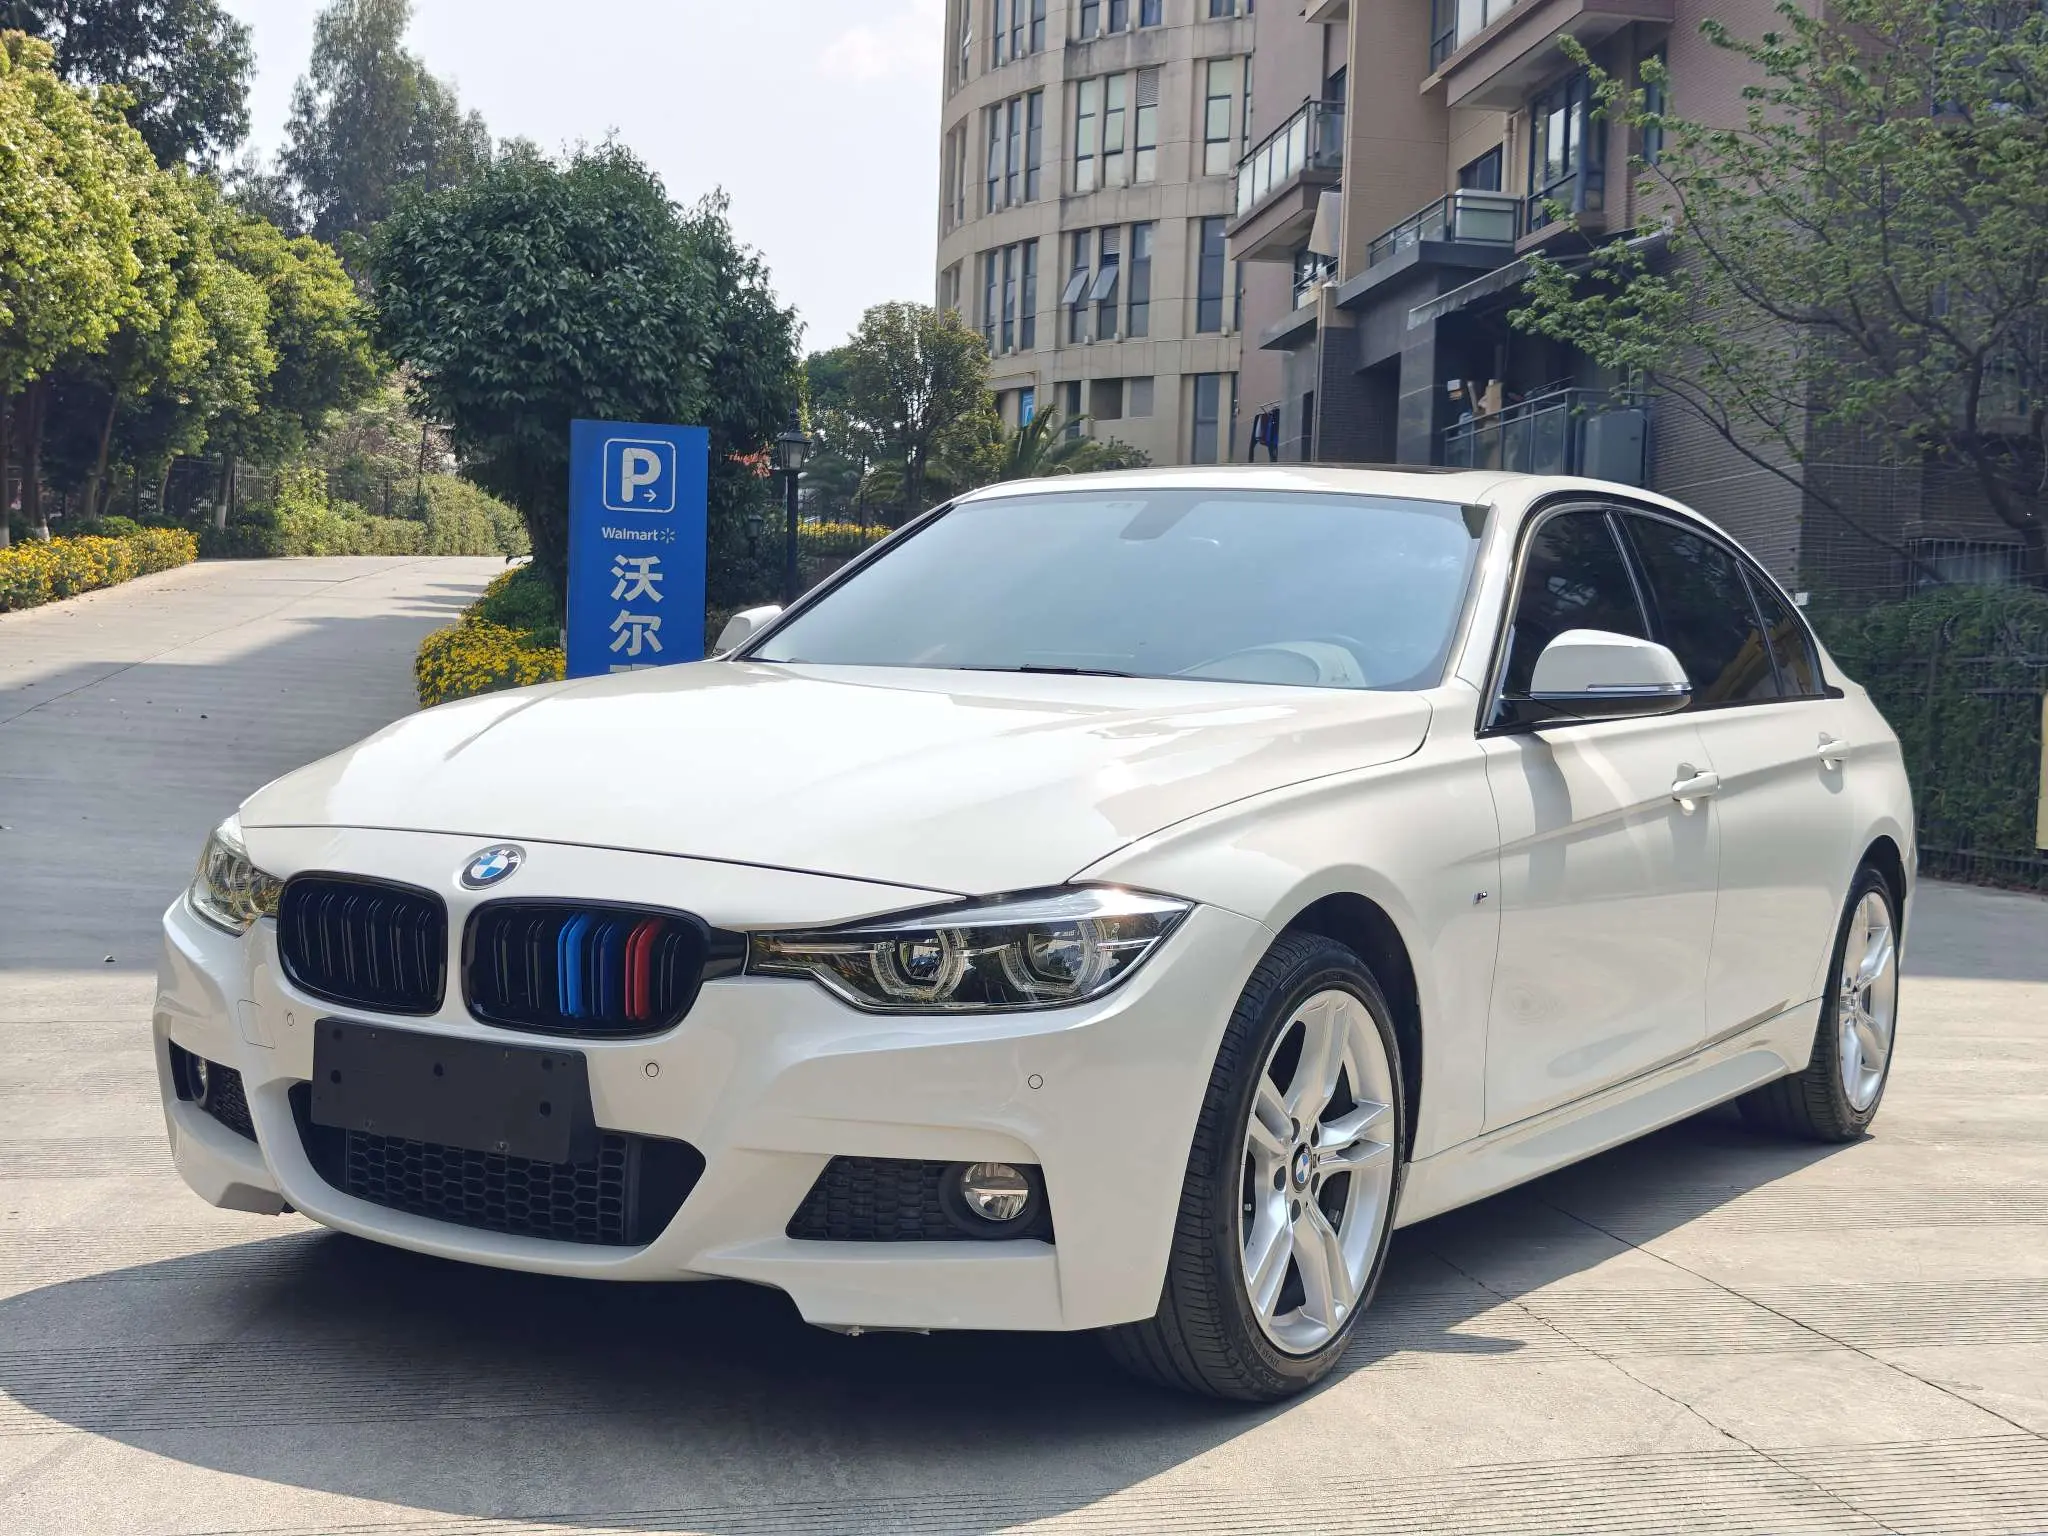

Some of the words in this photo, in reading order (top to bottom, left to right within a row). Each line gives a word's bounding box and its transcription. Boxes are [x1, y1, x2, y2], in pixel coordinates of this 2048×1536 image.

[621, 447, 662, 503] P
[601, 526, 658, 541] Walmart
[609, 554, 664, 673] 沃尔
